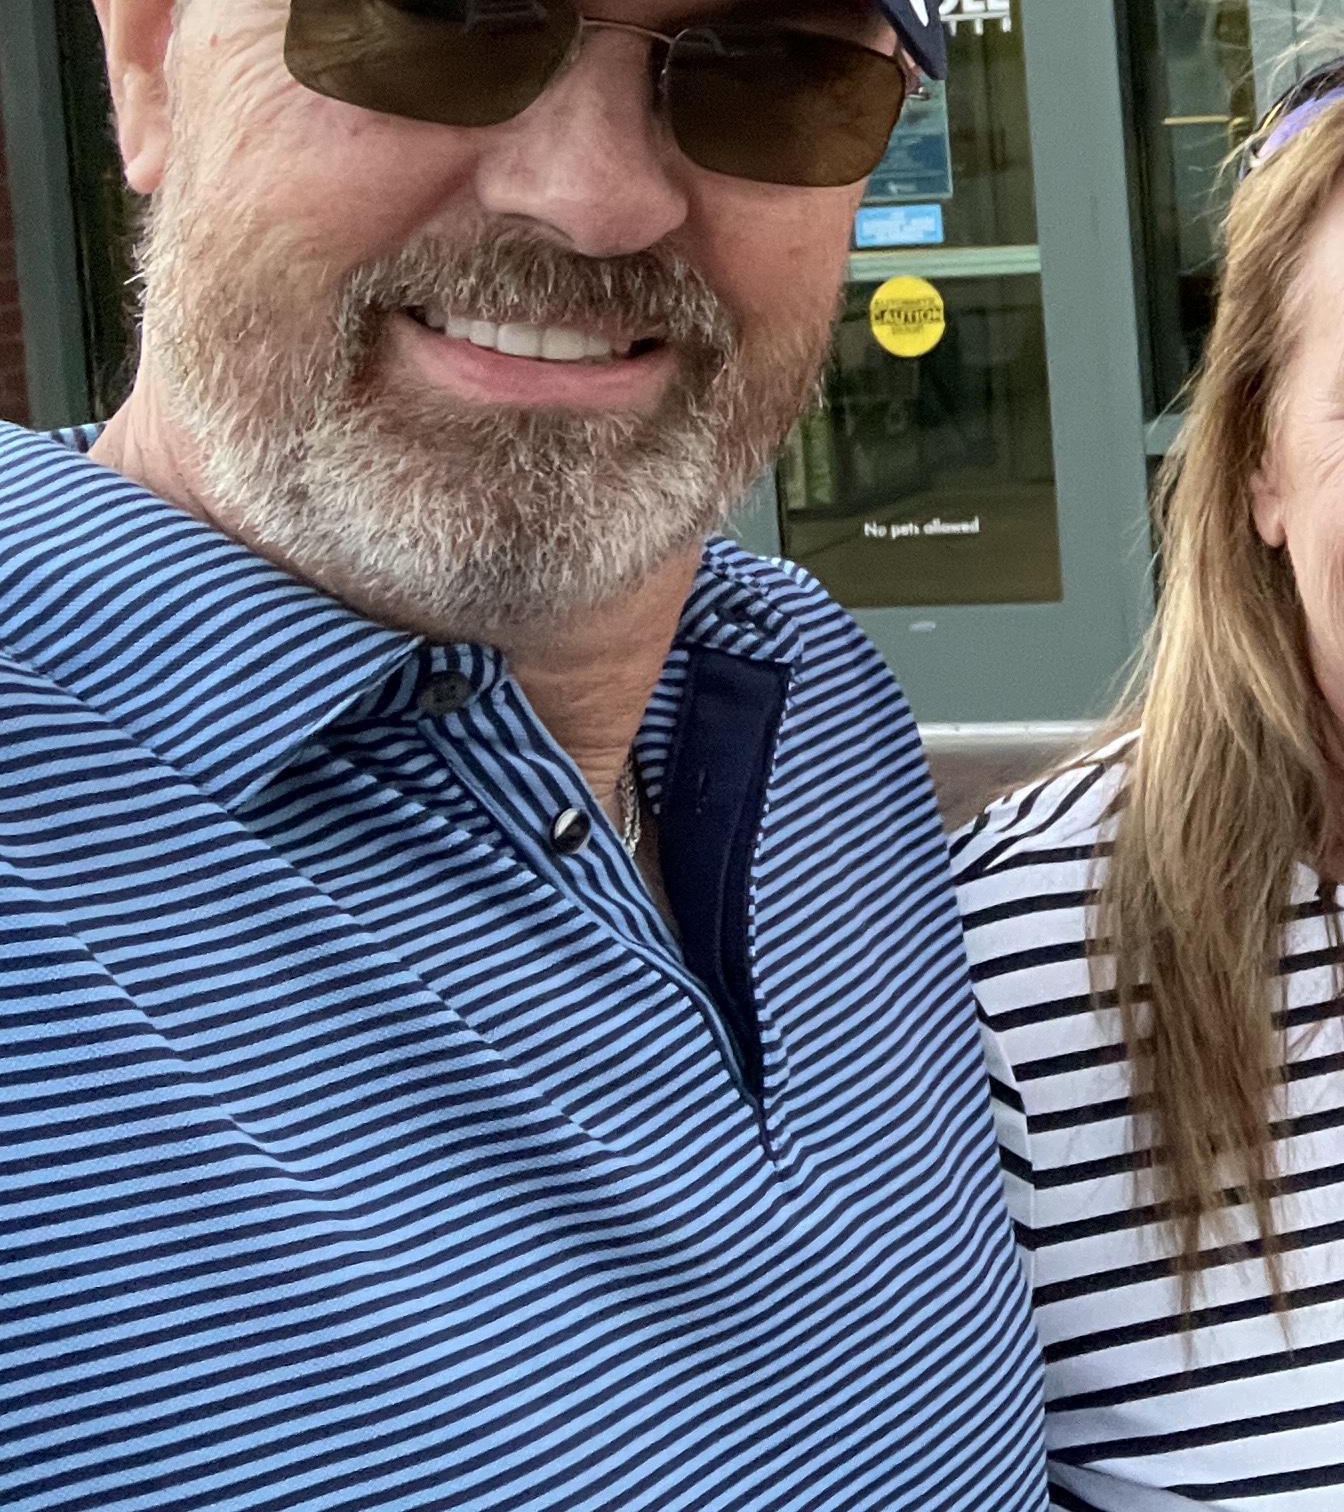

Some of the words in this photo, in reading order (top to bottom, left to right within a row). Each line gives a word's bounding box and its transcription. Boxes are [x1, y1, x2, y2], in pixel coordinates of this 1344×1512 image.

[863, 520, 888, 538] No
[890, 522, 920, 540] pets
[922, 515, 980, 535] allowed
